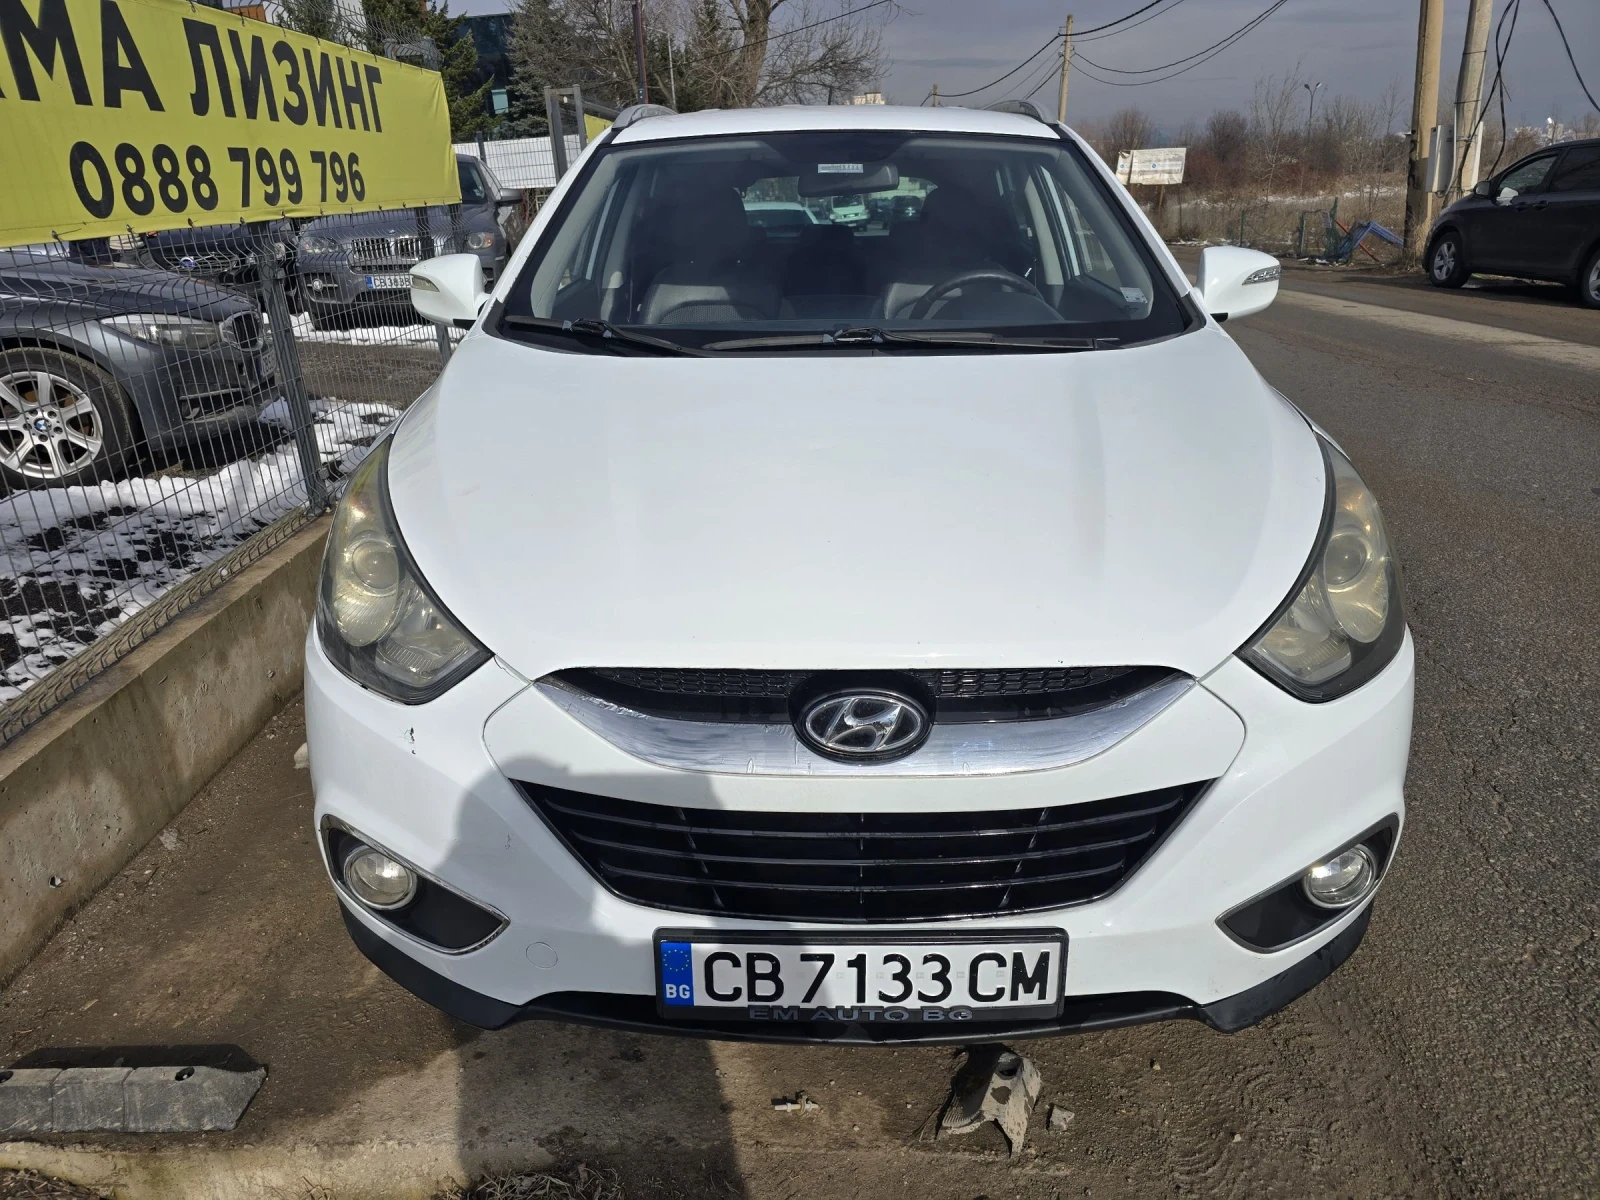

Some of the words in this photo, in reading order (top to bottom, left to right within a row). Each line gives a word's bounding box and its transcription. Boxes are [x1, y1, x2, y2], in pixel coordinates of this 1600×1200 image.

[0, 0, 164, 112] МА
[182, 17, 382, 133] ЛИЗИНГ
[70, 141, 218, 219] 0888
[227, 147, 302, 207] 799
[310, 151, 365, 203] 796
[665, 984, 690, 999] BG
[704, 951, 784, 1002] CB
[800, 953, 952, 1004] 7133
[969, 951, 1050, 1002] CM
[749, 1007, 799, 1021] EM
[810, 1007, 910, 1021] AUTO
[922, 1007, 973, 1021] BG
